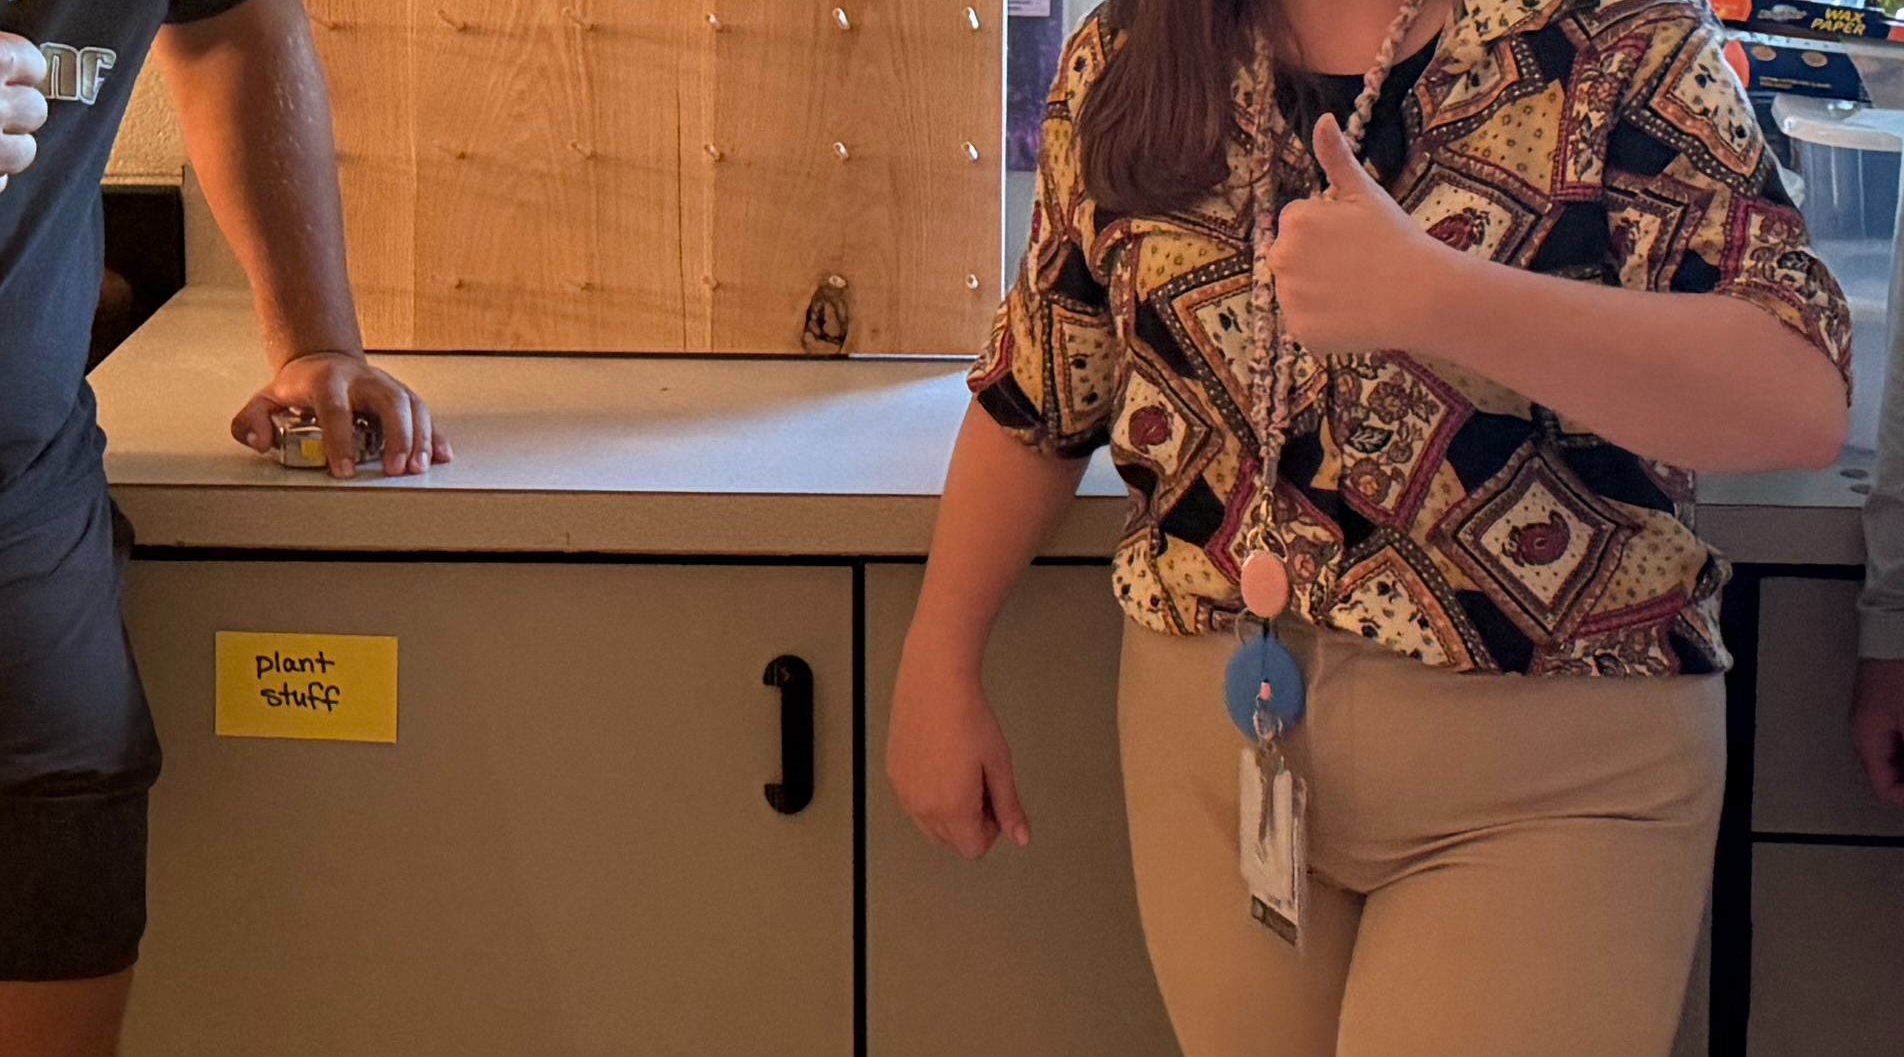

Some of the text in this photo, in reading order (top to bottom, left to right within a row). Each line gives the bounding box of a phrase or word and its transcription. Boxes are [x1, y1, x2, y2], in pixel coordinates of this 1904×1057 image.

[1810, 17, 1867, 36] PAPER
[1824, 7, 1864, 23] WAX
[255, 650, 336, 679] plant
[260, 681, 341, 712] stuff
